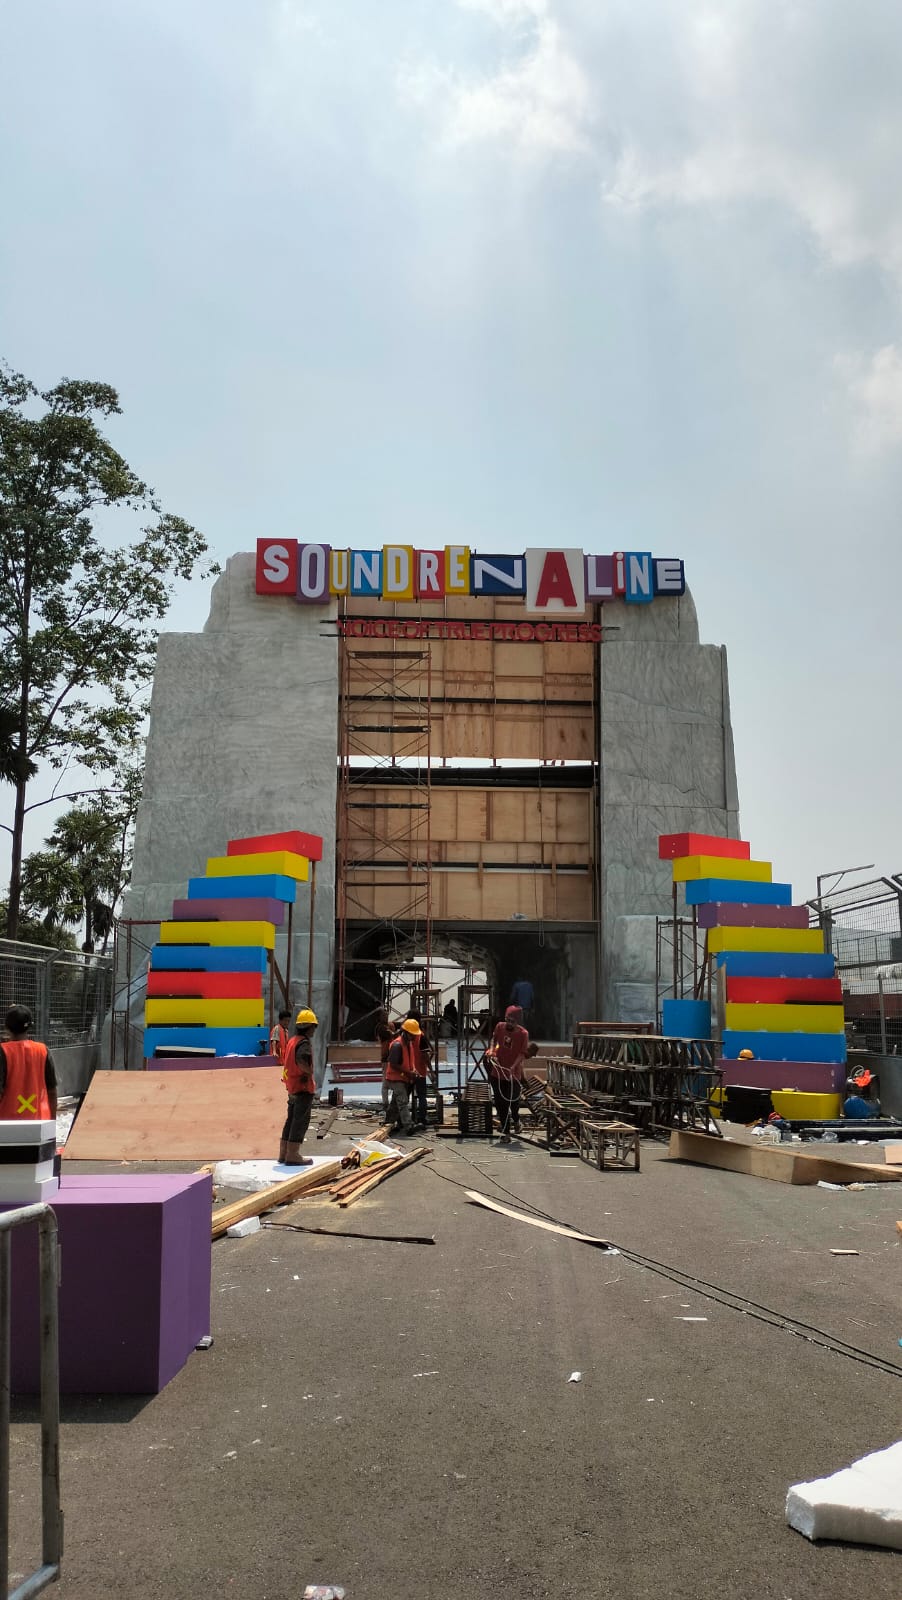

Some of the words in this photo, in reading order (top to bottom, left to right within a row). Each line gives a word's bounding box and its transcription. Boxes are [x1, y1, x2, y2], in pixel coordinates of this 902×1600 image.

[336, 618, 400, 638] VOICE
[401, 620, 430, 638] OF
[429, 620, 489, 641] TRUE
[490, 622, 602, 642] PROGRESS
